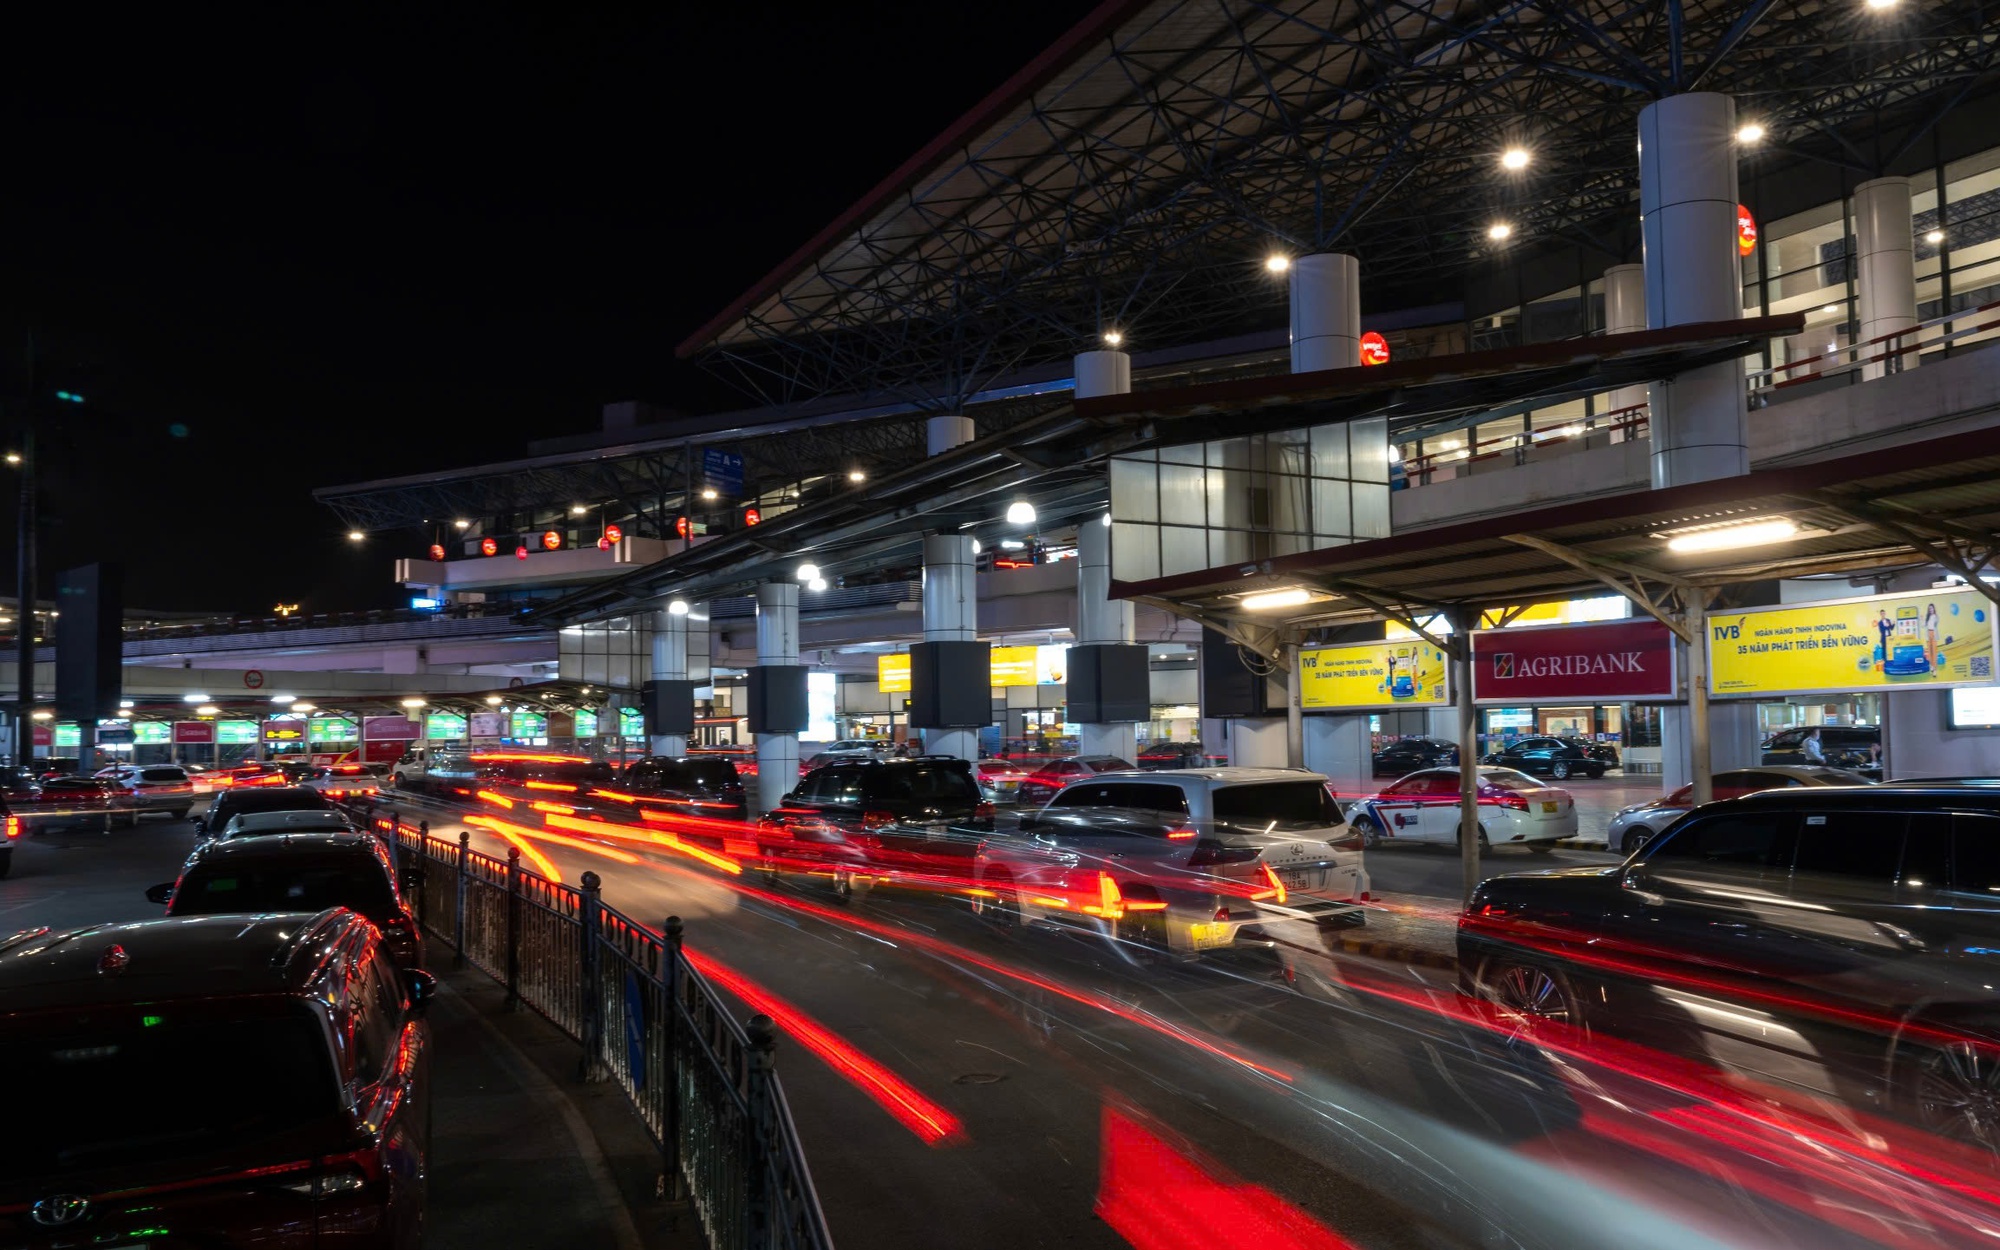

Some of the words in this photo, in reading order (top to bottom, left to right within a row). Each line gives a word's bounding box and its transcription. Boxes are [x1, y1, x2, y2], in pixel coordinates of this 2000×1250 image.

[1714, 625, 1740, 641] IVB
[1795, 624, 1812, 634] TNHH
[1814, 622, 1847, 632] INDOVINA
[1738, 645, 1747, 655] 35
[1750, 642, 1769, 653] NĂM
[1771, 639, 1793, 651] PHÁT
[1795, 635, 1819, 650] TRIỂN
[1303, 657, 1317, 668] IVB
[1517, 652, 1646, 678] AGRIBANK
